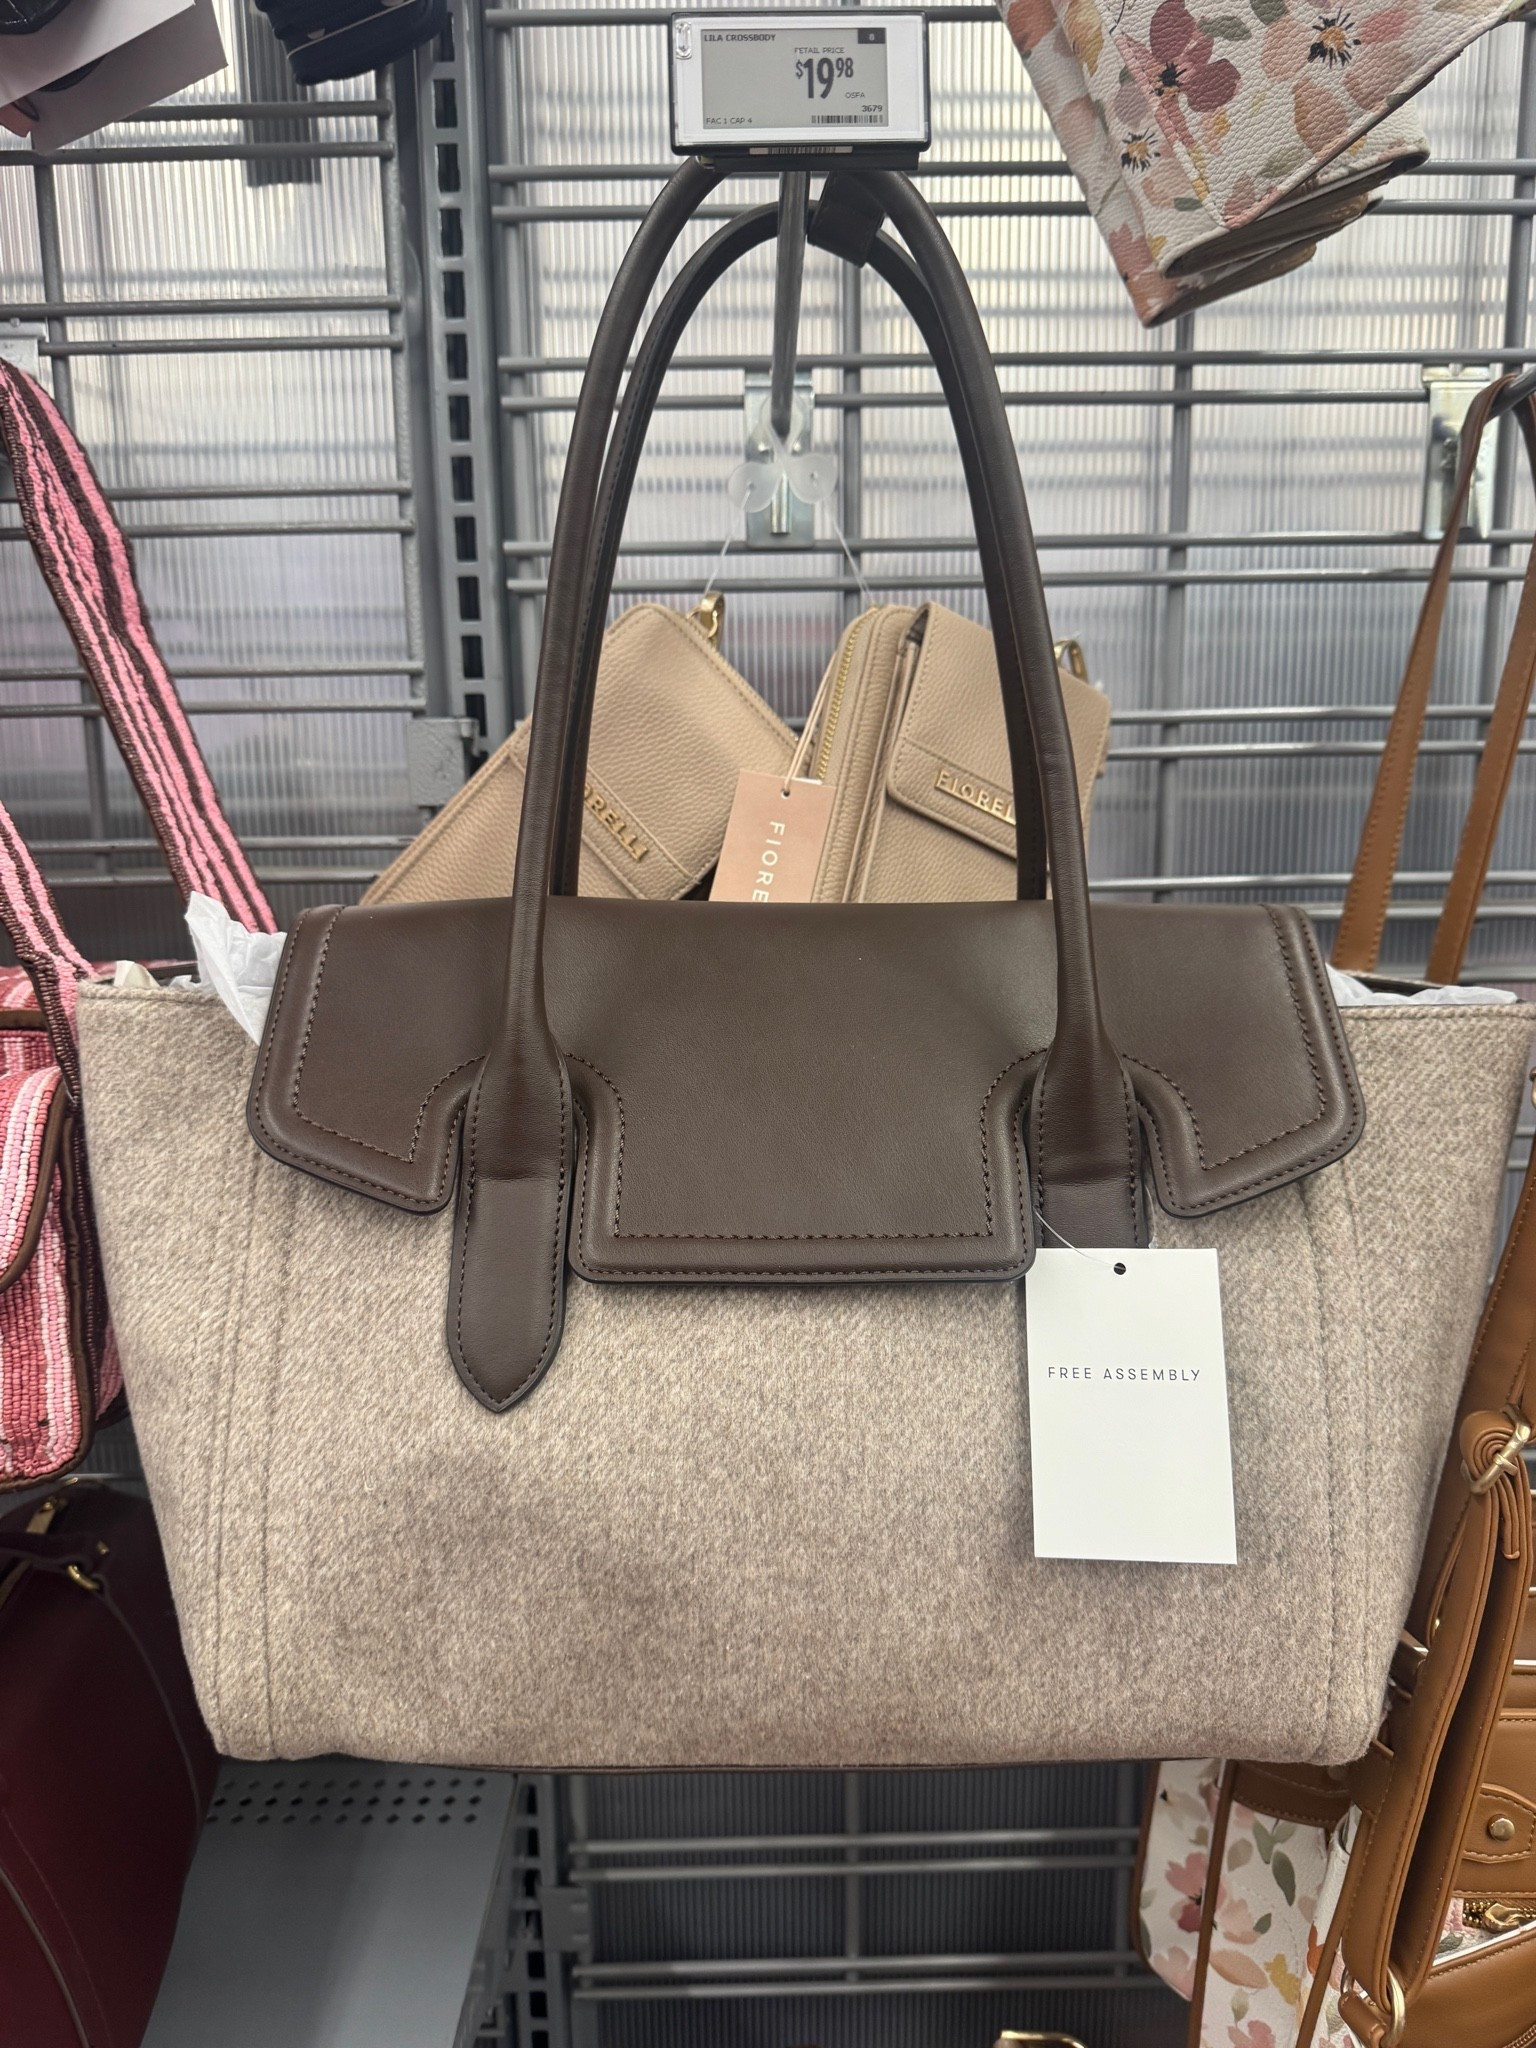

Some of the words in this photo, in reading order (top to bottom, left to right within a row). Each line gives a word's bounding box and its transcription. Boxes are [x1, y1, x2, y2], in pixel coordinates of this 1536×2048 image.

[704, 33, 723, 42] LILA
[725, 33, 776, 42] CROSSBODY
[862, 105, 883, 113] 3679
[751, 820, 786, 903] FIORE
[1047, 1366, 1093, 1380] FREE
[1103, 1367, 1201, 1382] ASSEMBLY
